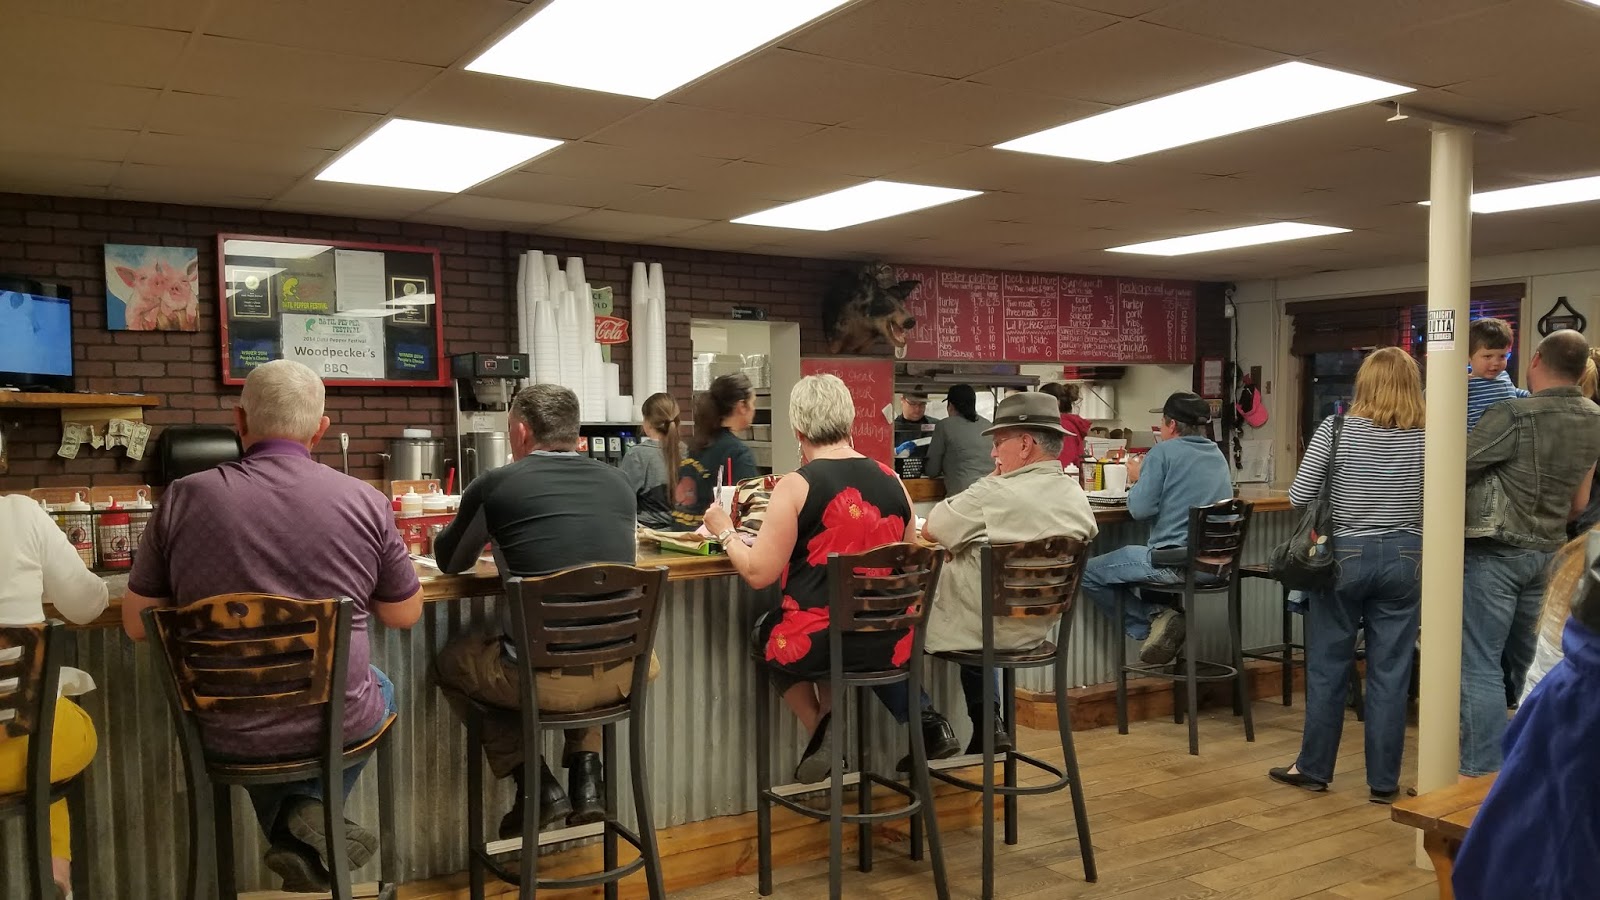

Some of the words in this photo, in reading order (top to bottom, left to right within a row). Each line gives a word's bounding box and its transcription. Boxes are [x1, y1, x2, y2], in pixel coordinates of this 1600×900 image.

[1121, 298, 1144, 313] turkey
[1126, 310, 1143, 323] pork
[294, 346, 376, 359] Woodpecker's
[1045, 346, 1053, 357] 6
[1119, 342, 1149, 353] chicken
[324, 363, 350, 375] BBQ
